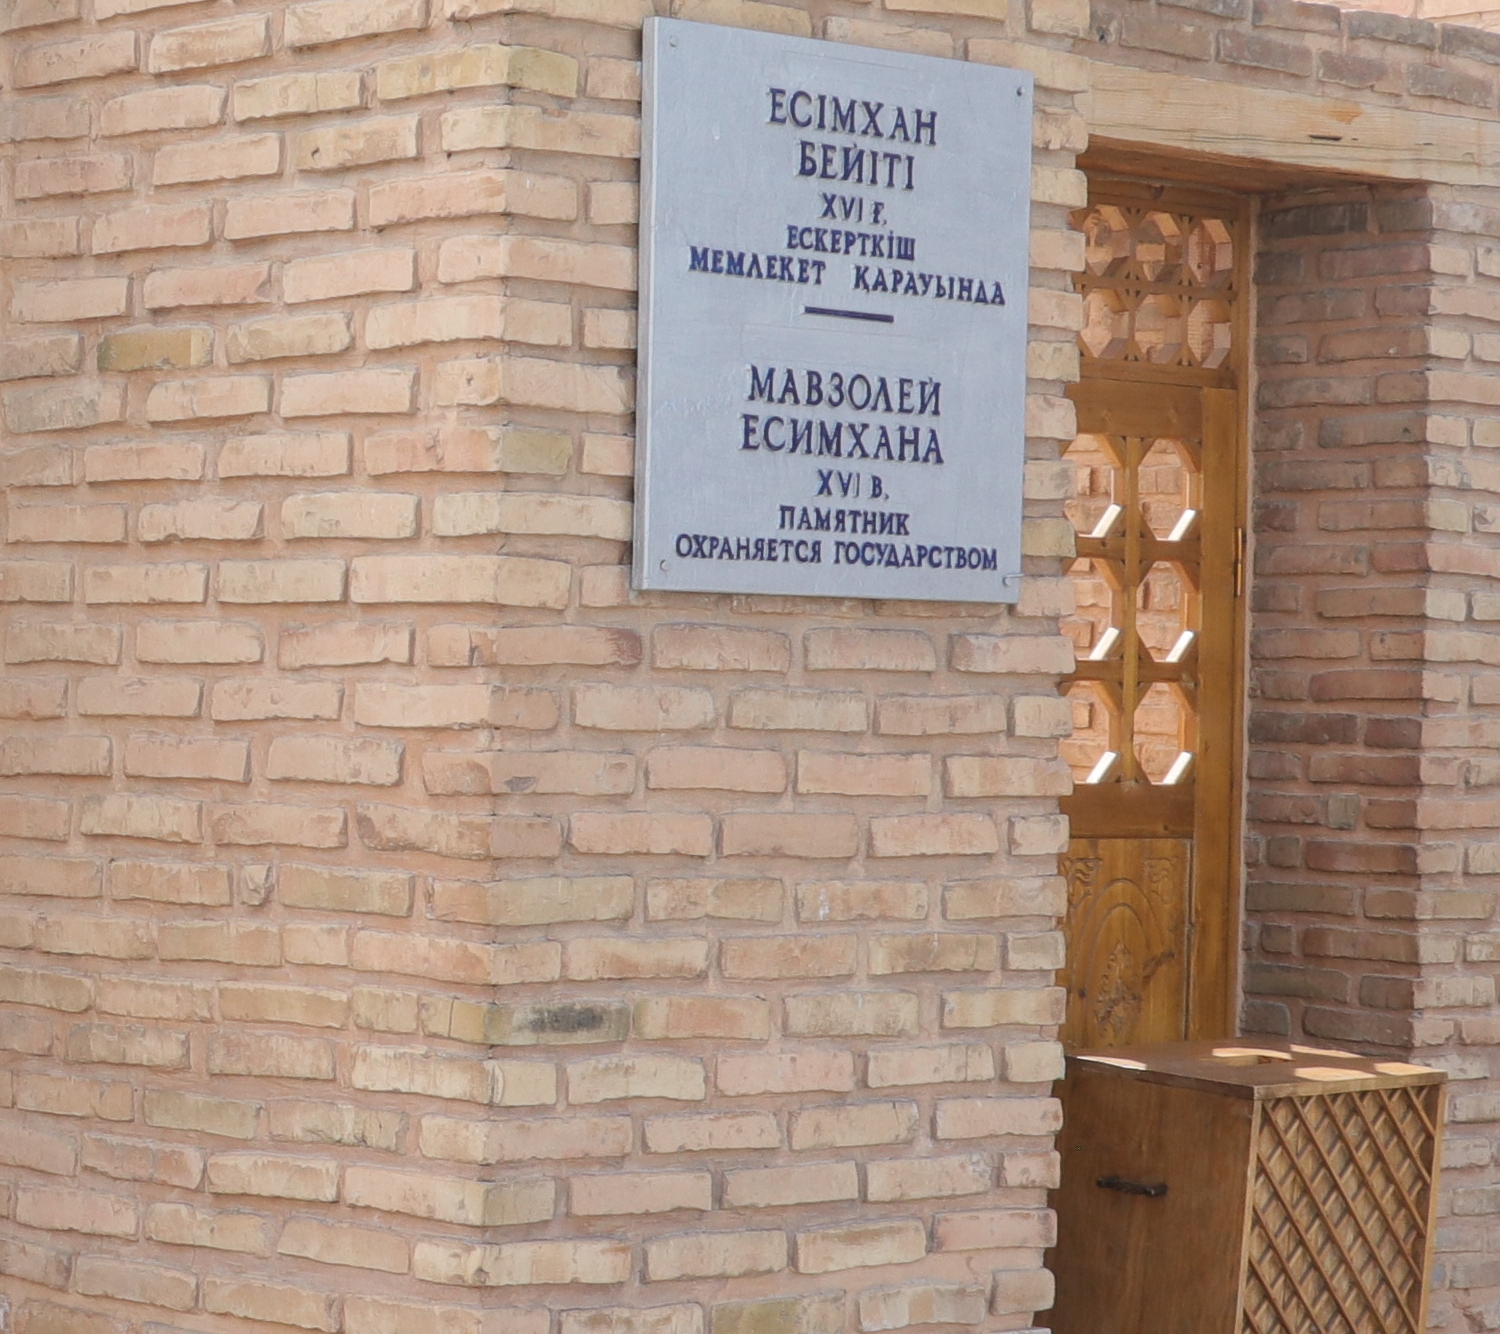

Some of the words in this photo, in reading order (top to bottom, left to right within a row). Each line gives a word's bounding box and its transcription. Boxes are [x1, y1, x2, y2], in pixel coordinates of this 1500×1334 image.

[768, 87, 938, 146] ЕСІМХАН
[799, 140, 915, 190] БЕЙІТІ
[821, 193, 864, 223] XVI
[688, 245, 826, 285] МЕМЛЕКЕТ
[854, 264, 1006, 306] ҚАРАУЫНДА
[748, 364, 941, 416] МАВЗОЛЕЙ
[740, 413, 944, 464] ЕСИМХАНА
[817, 469, 860, 497] XVI
[778, 504, 910, 535] ПАМЯТНИК
[675, 534, 822, 564] ОХРАНЯЕТСЯ
[833, 540, 998, 570] ГОСУДАРСТВОМ
